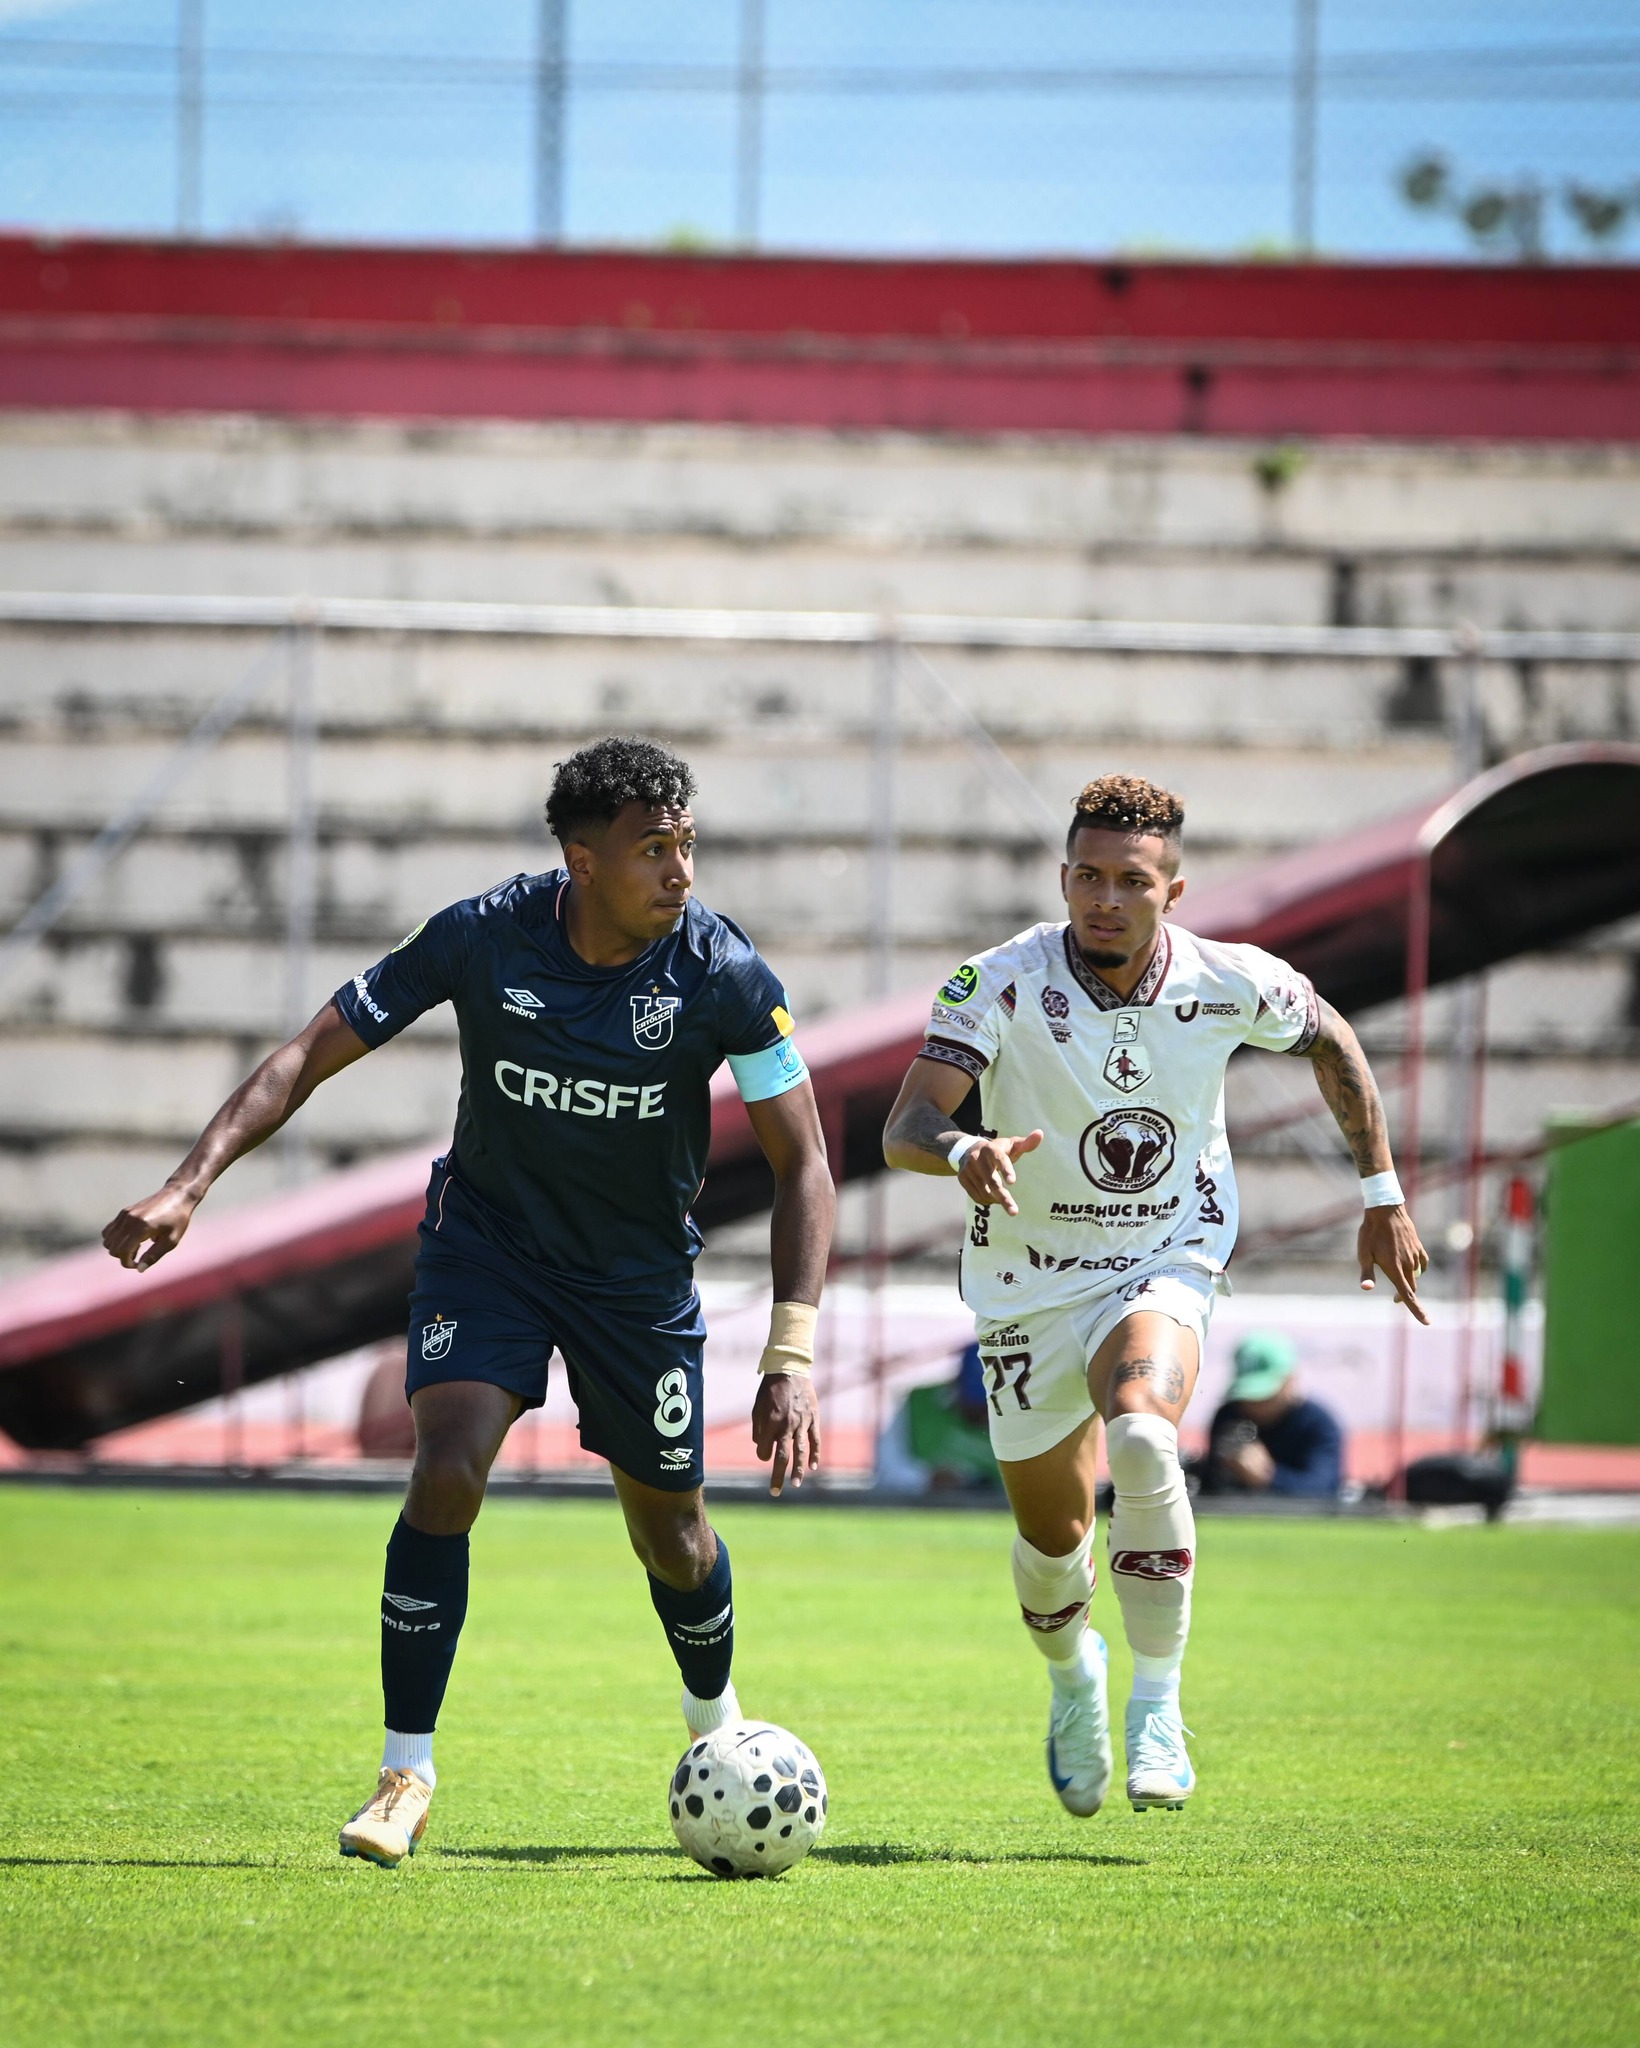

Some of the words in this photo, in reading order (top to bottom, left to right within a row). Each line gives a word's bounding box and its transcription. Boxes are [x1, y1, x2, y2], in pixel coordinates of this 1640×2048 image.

[502, 1001, 537, 1020] umbro
[1100, 1113, 1138, 1132] MUSHUC
[1140, 1114, 1165, 1132] RUNA
[1050, 1202, 1132, 1218] MUSHUC
[1050, 1215, 1103, 1228] COOPERATIVA
[1105, 1220, 1115, 1228] DE
[978, 1352, 1032, 1417] 77
[654, 1367, 692, 1438] 8
[660, 1462, 691, 1471] umbro
